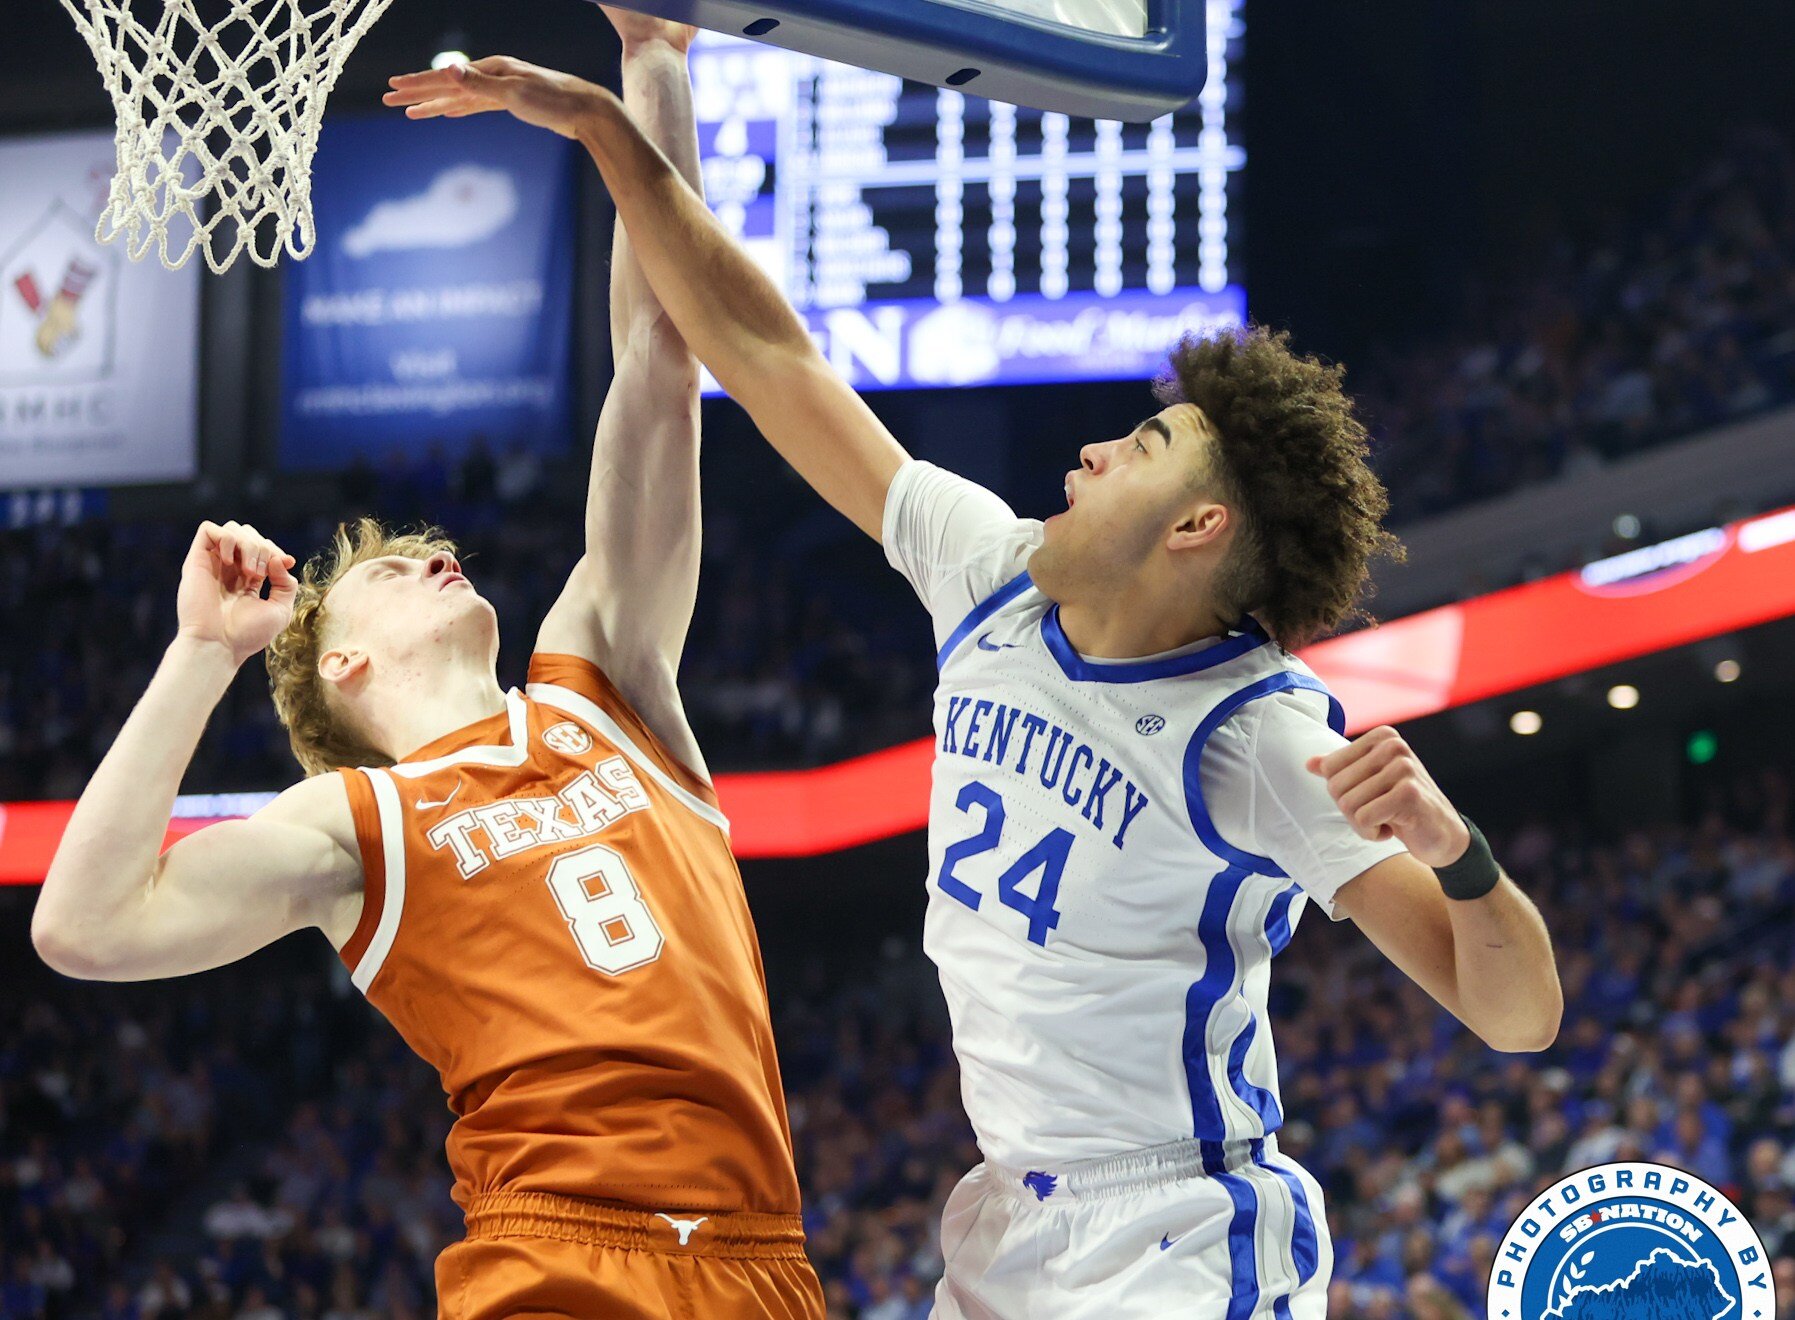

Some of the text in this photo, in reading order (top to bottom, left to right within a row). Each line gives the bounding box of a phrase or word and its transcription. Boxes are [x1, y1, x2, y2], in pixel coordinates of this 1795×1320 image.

[543, 722, 591, 754] SEC
[943, 696, 1149, 850] KENTUCKY
[426, 754, 652, 880] TEXAS
[937, 780, 1076, 948] 24
[545, 843, 666, 977] 8
